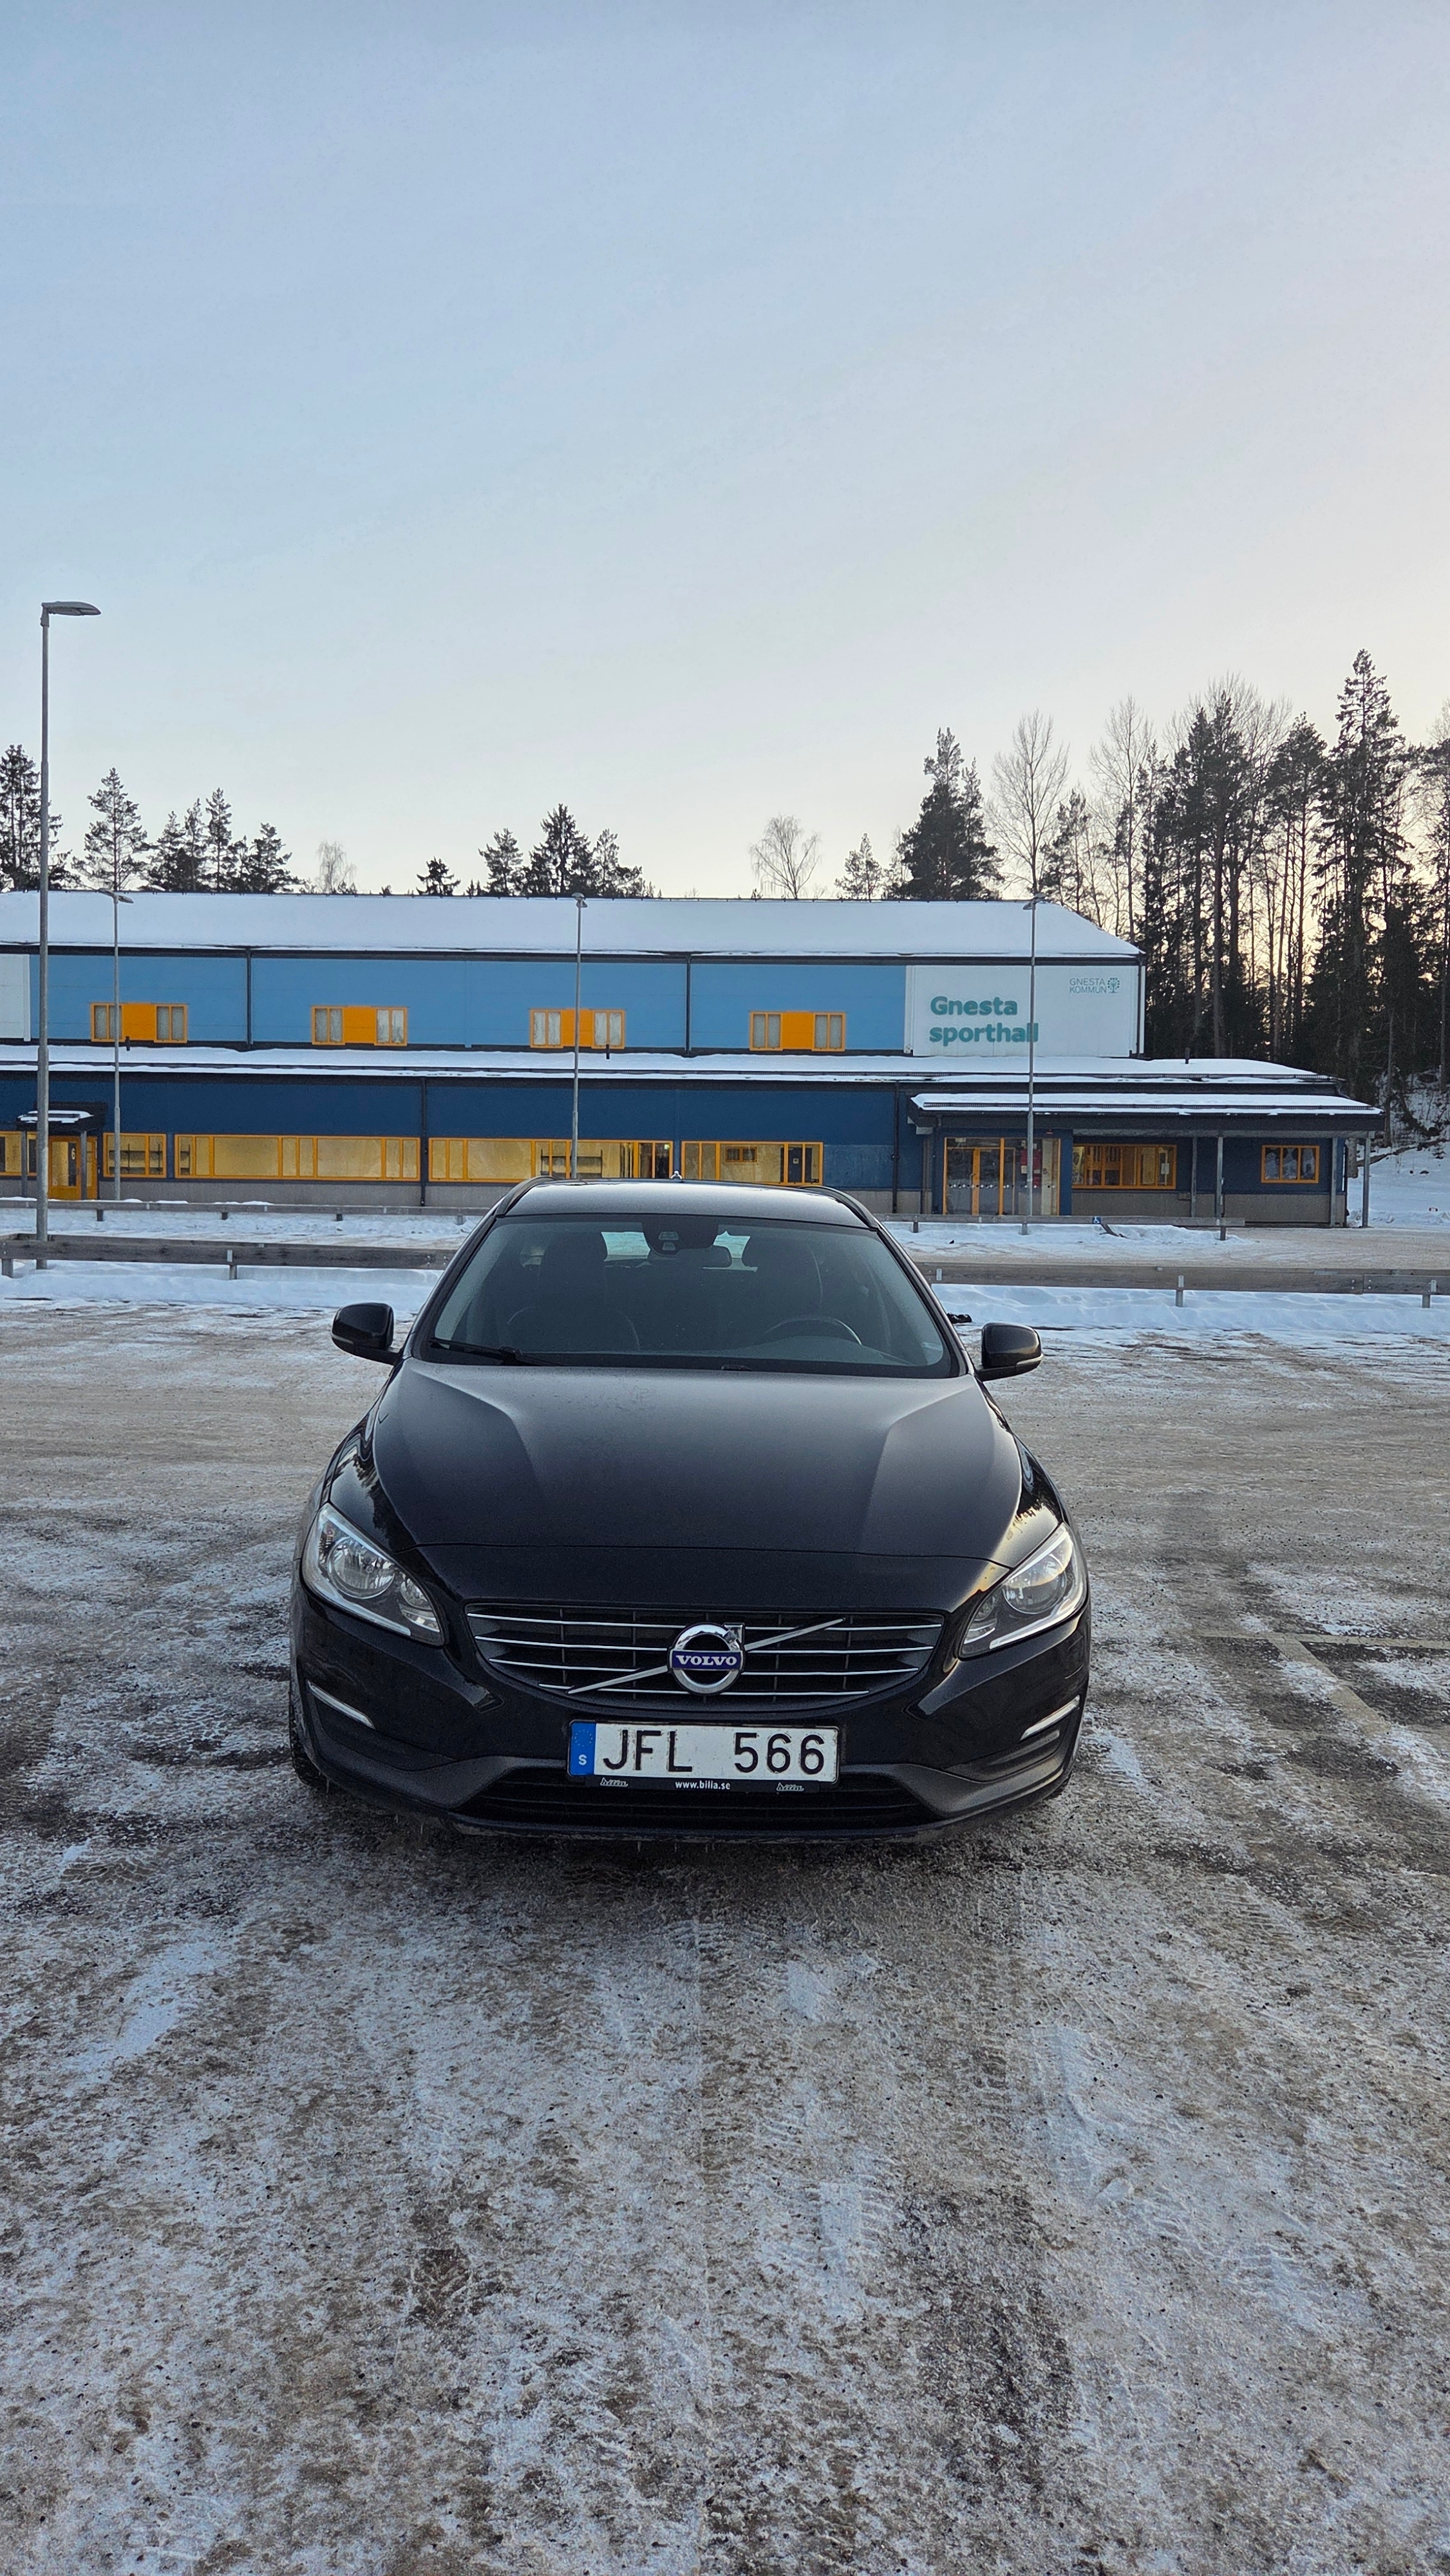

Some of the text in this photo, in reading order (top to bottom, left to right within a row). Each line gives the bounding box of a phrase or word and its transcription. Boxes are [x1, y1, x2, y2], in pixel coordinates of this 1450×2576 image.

[1069, 978, 1106, 986] GNESTA
[930, 996, 1017, 1016] Gnesta
[929, 1022, 1039, 1046] sporthall
[71, 1148, 76, 1160] 6
[675, 1654, 737, 1666] VOLVO
[603, 1729, 825, 1775] JFL 566
[578, 1754, 587, 1766] S
[675, 1780, 731, 1790] www.bilia.se
